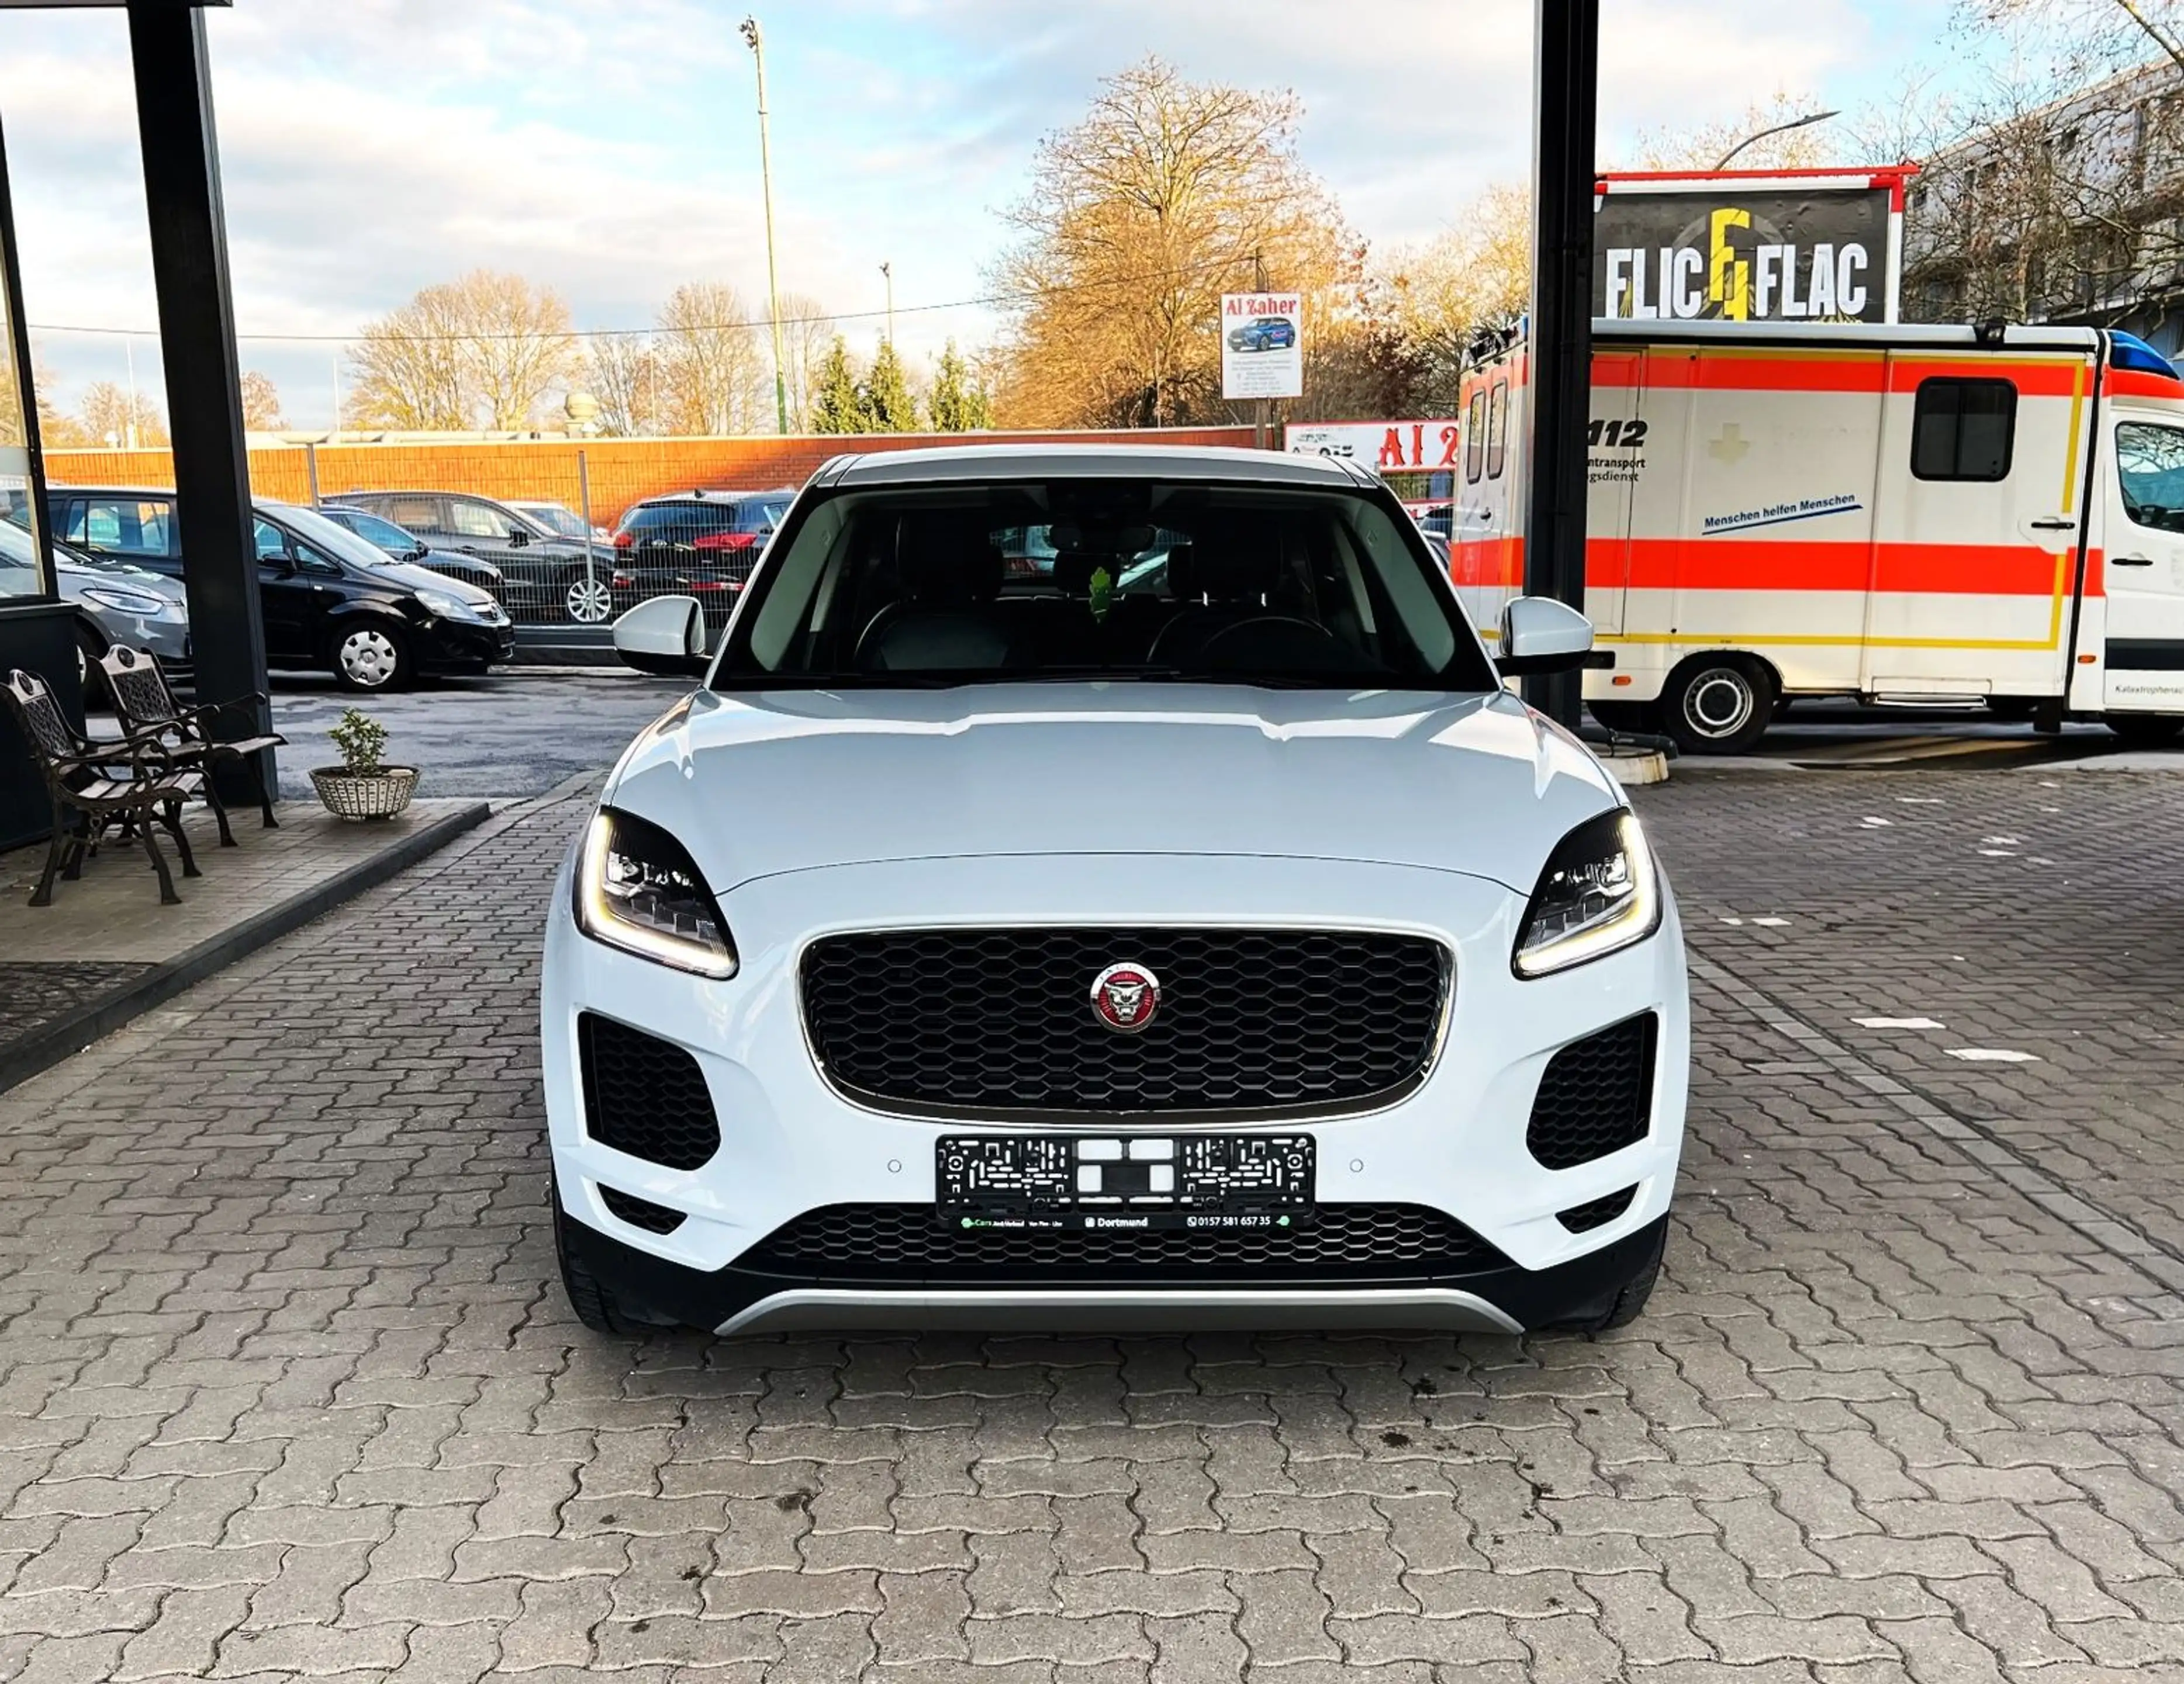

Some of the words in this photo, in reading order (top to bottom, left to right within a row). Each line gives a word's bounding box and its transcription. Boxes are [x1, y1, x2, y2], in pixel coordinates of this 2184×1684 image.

[1605, 247, 1703, 319] FLIC
[1756, 243, 1868, 316] FLAC
[1246, 296, 1297, 315] Zaher
[1703, 509, 1760, 528] Menschen
[1763, 504, 1798, 518] helfen
[1799, 493, 1856, 512] Menschen
[1097, 1216, 1149, 1227] Dortmund
[1197, 1216, 1221, 1226] 0157
[1222, 1216, 1238, 1226] 581
[1240, 1216, 1258, 1227] 657
[1259, 1215, 1271, 1226] 35
